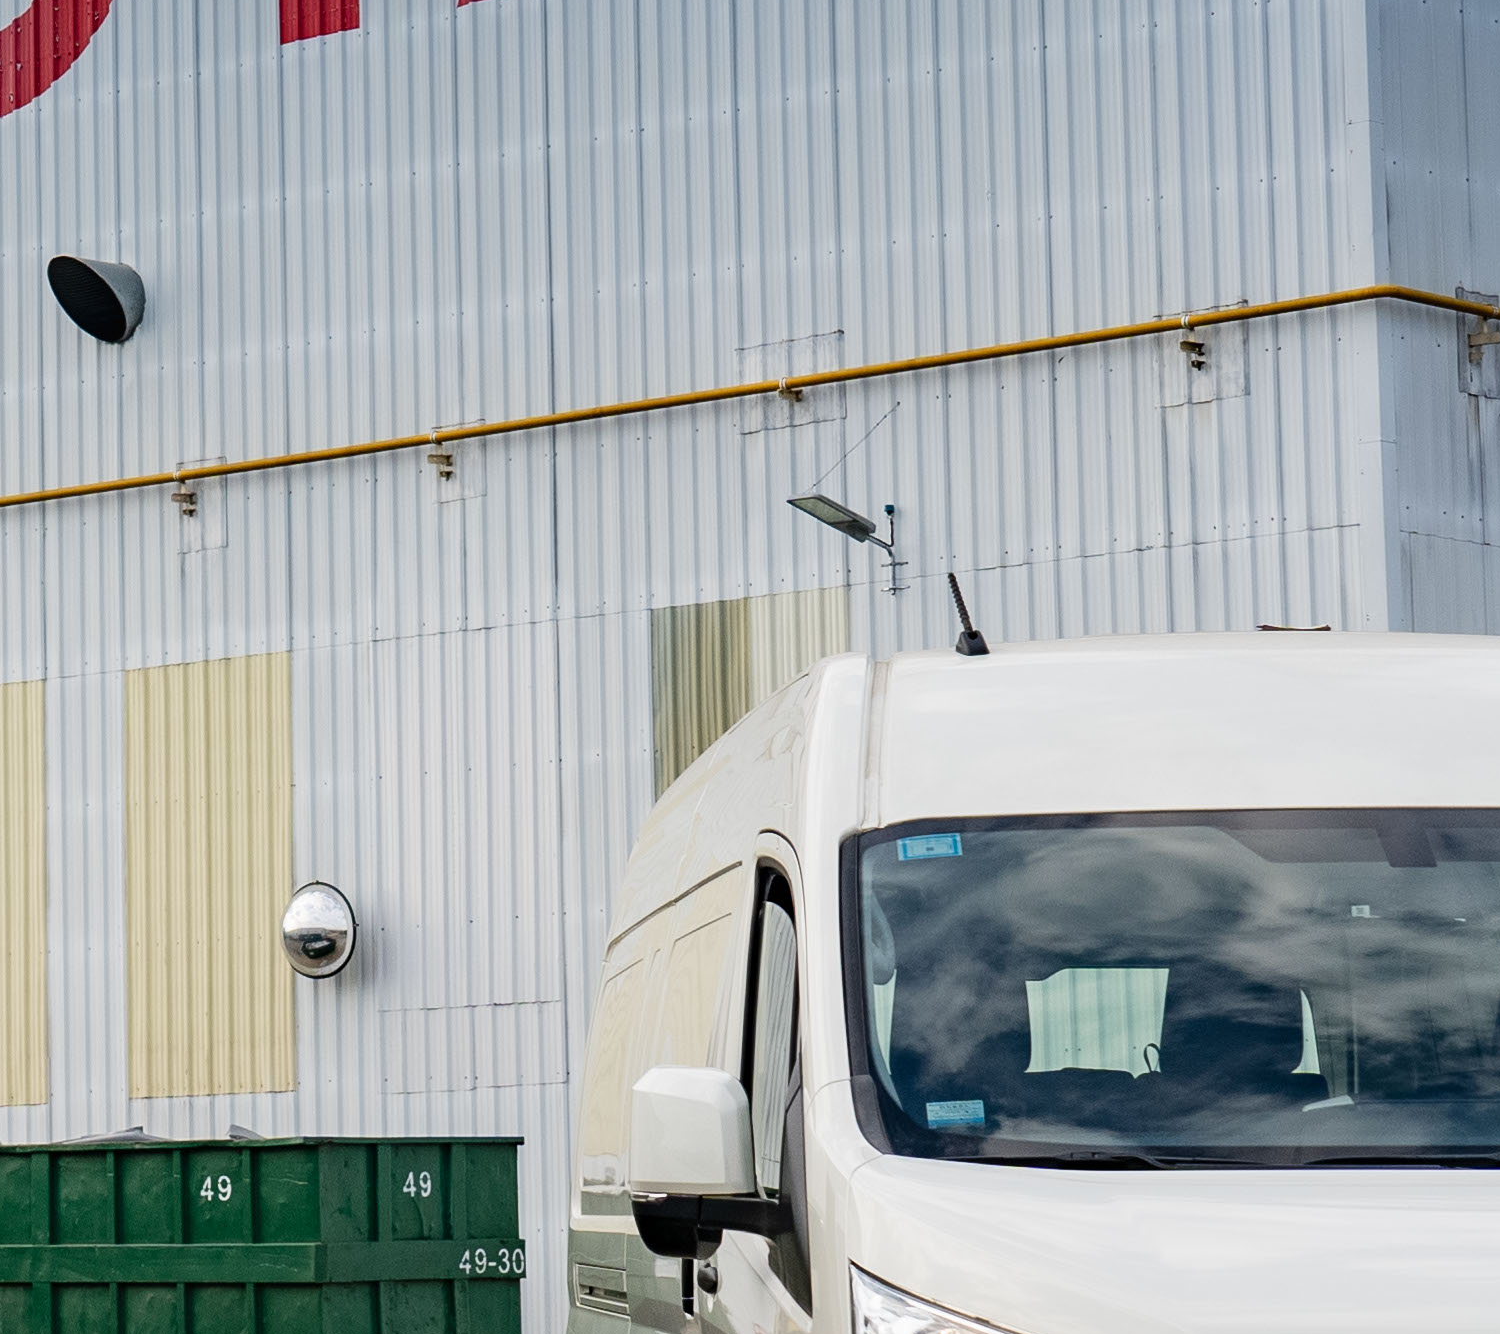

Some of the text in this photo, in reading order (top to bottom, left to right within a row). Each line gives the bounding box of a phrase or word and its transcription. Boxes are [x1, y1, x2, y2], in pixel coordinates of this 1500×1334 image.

[200, 1175, 232, 1201] 49
[403, 1171, 431, 1197] 49
[459, 1248, 525, 1274] 49-30
